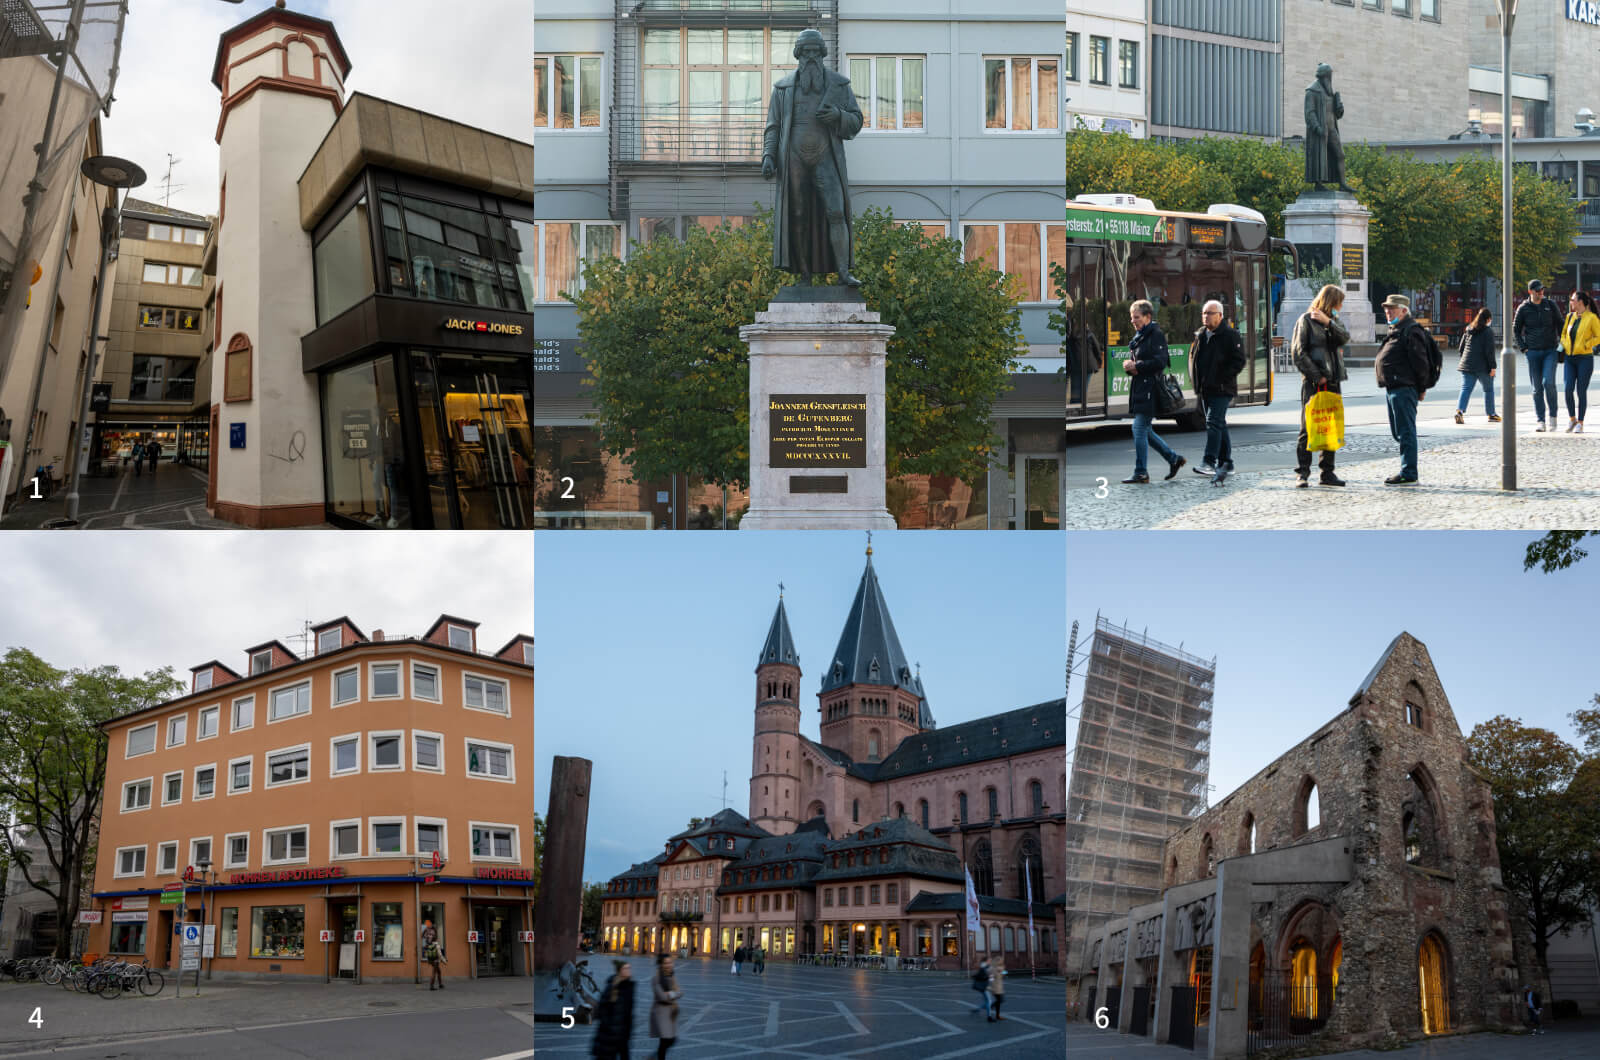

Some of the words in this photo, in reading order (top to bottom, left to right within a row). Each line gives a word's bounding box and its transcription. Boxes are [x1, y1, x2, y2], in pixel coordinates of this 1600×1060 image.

[1096, 218, 1104, 233] 21
[1109, 219, 1129, 234] 55118
[1130, 221, 1151, 236] Mainz
[446, 318, 475, 330] JACK
[488, 323, 522, 335] JONES
[797, 413, 853, 422] GUTENBERG
[230, 871, 276, 883] MOHREN
[280, 865, 344, 880] APOTHEKE
[479, 867, 532, 880] MOHREN
